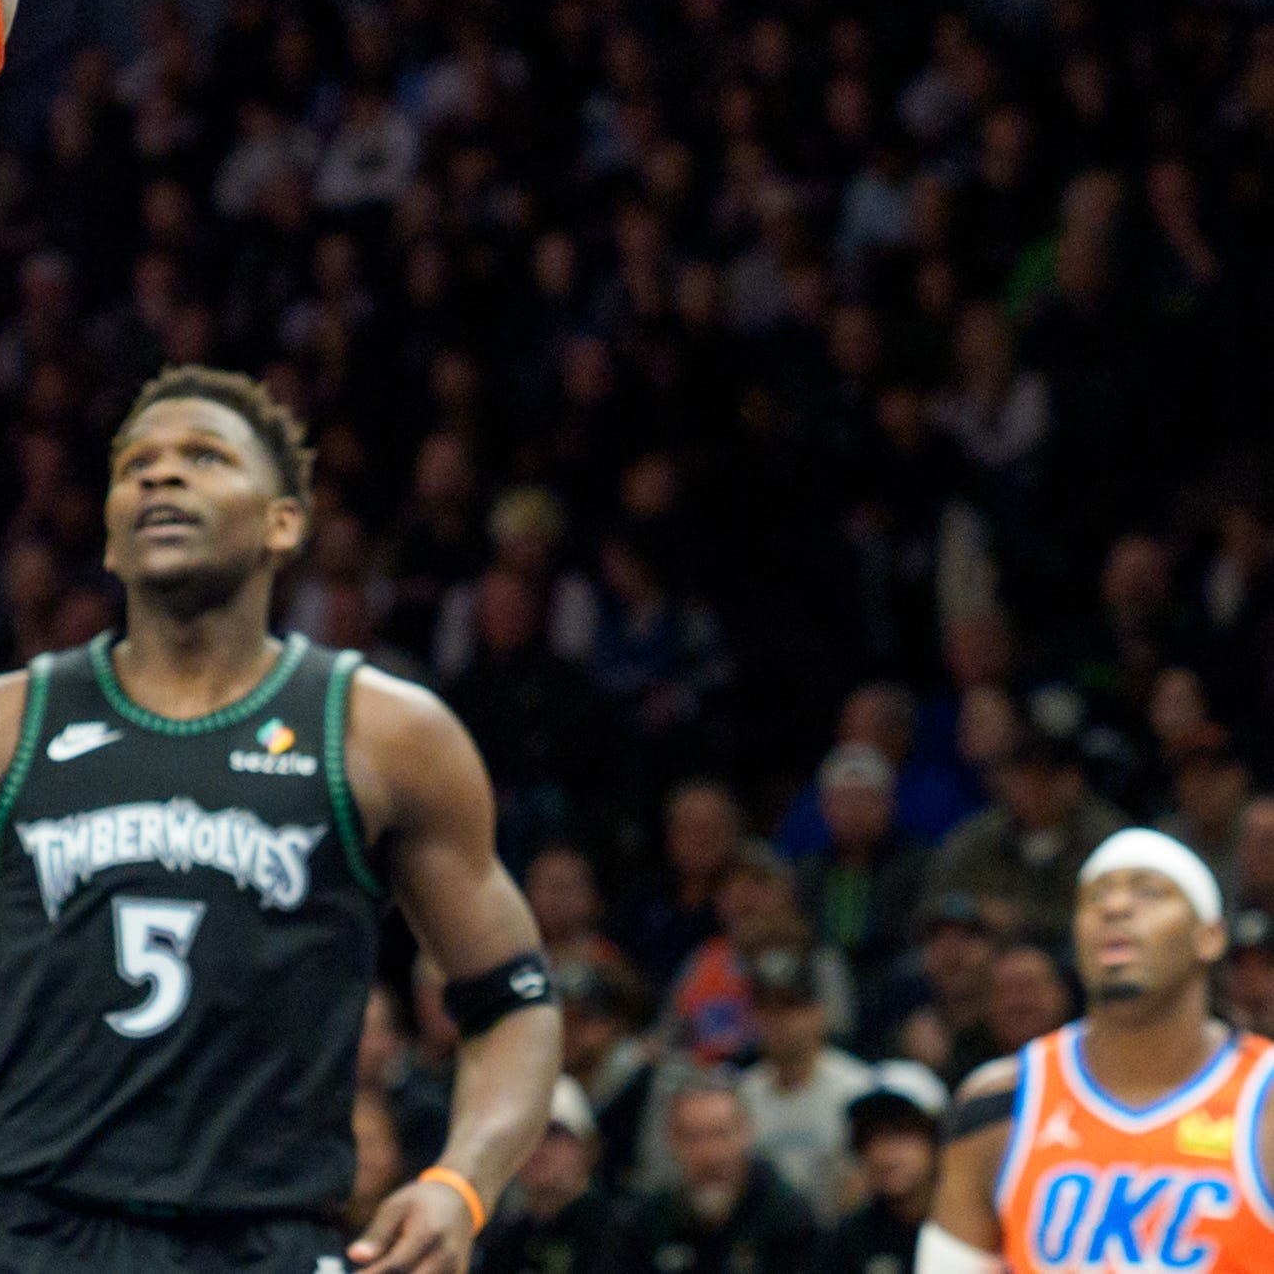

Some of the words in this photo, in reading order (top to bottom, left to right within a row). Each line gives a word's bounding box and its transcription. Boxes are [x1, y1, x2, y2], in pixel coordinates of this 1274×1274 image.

[14, 793, 329, 923] TIMBERWOLVES
[103, 894, 208, 1039] 5
[1025, 1161, 1238, 1274] OKC
